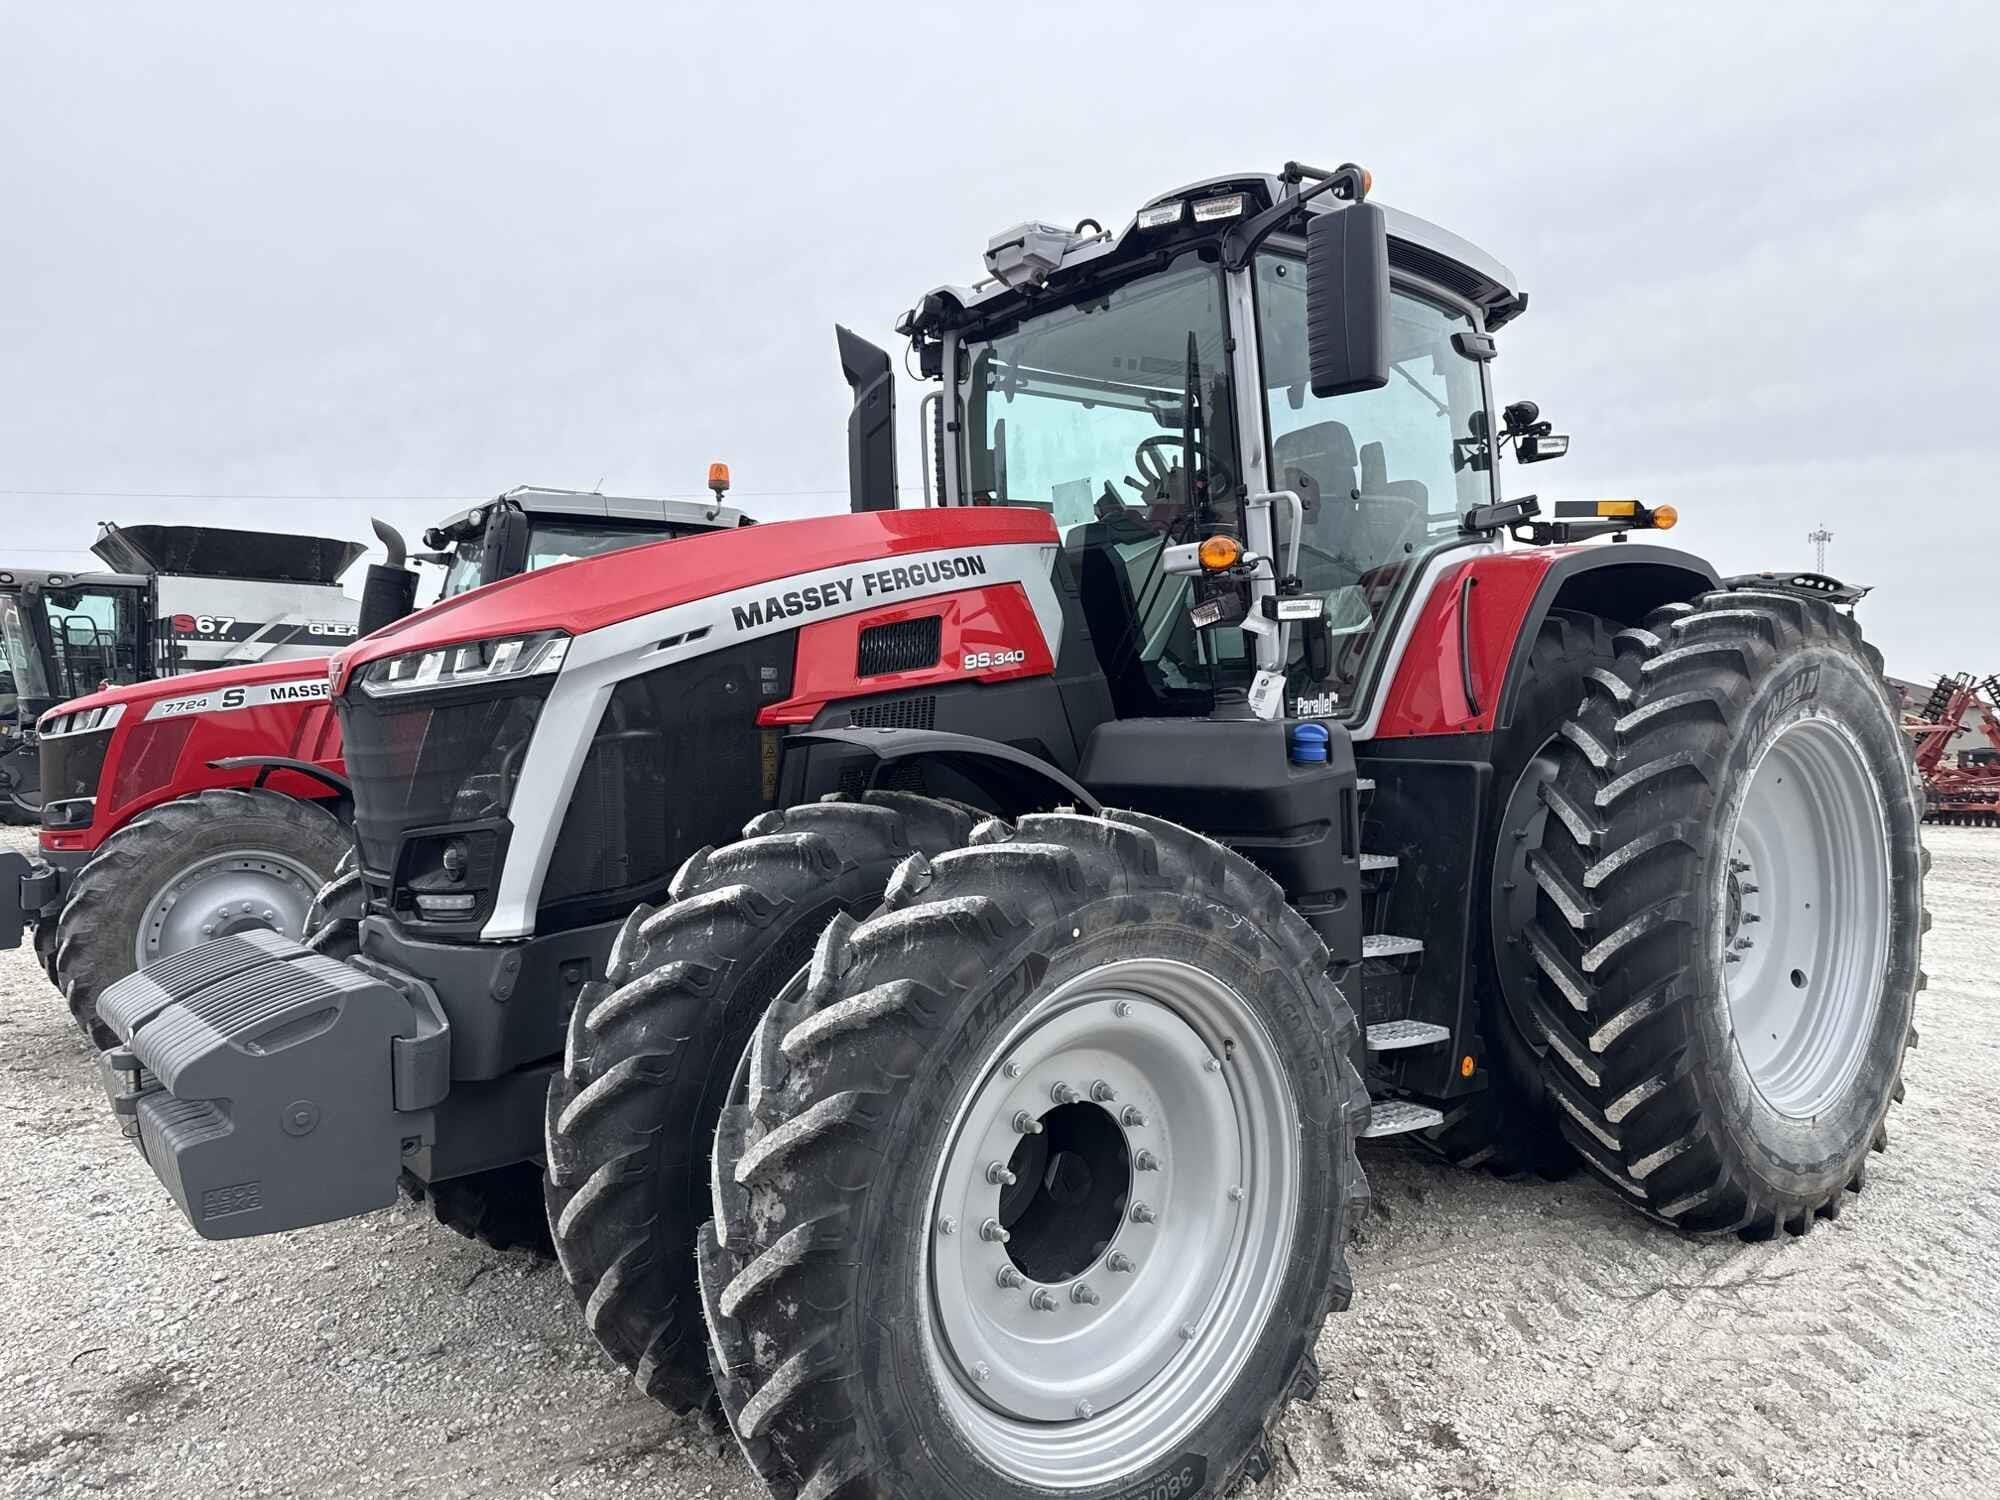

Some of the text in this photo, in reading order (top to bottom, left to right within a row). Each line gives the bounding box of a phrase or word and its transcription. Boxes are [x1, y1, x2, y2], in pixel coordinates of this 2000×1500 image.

[731, 555, 986, 631] MASSEY FERGUSON
[173, 614, 235, 634] S67
[964, 650, 1025, 669] 9S.340
[165, 699, 207, 712] 7724
[222, 688, 246, 708] S
